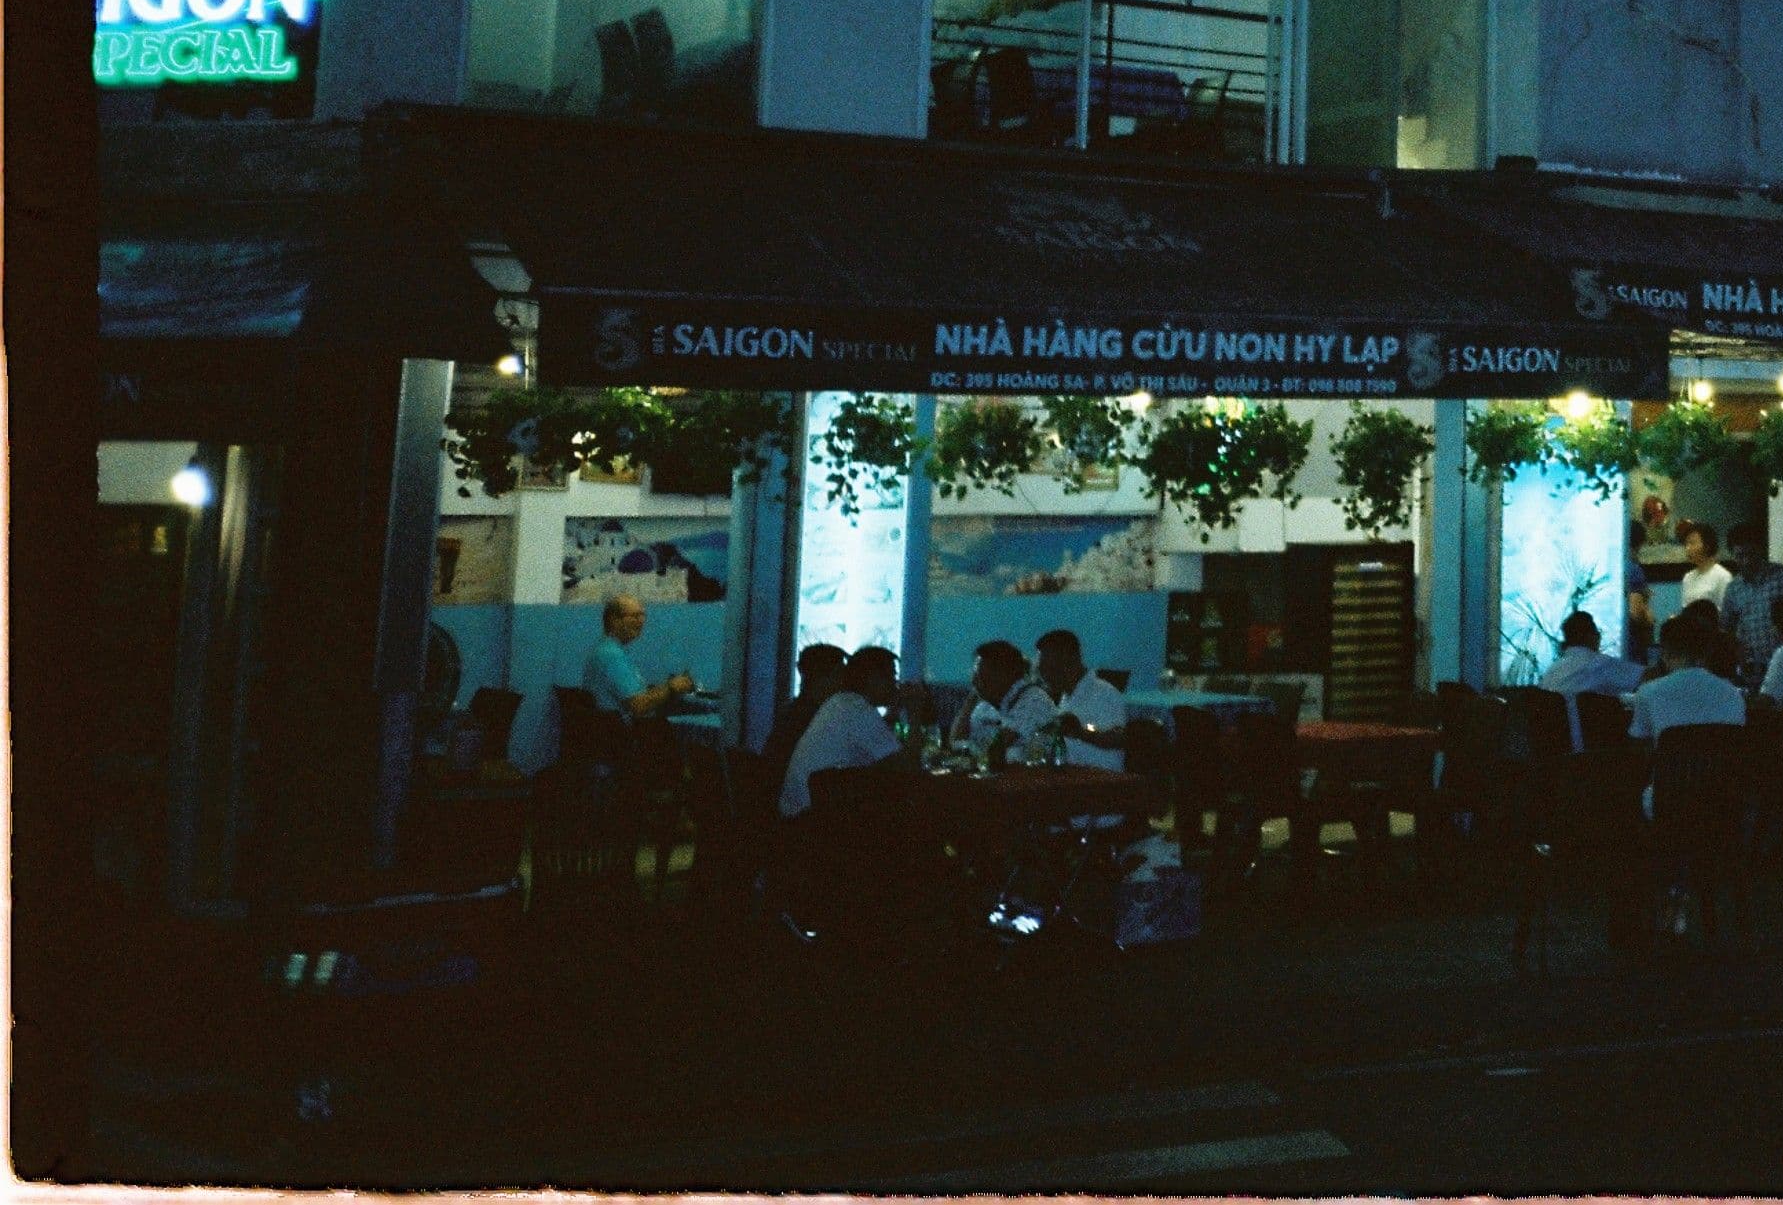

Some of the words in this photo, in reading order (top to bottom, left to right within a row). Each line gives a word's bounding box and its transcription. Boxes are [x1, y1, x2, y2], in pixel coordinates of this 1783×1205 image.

[1616, 284, 1688, 310] SAIGON
[1702, 279, 1763, 314] NHÀ
[672, 324, 814, 359] SAIGON
[935, 316, 1013, 356] NHÀ
[1022, 318, 1124, 360] HÀNG
[1131, 322, 1207, 361] CỪU
[1214, 331, 1286, 362] NON
[1293, 334, 1336, 363] HY
[1342, 334, 1399, 373] LẠP
[1462, 345, 1560, 373] SAIGON
[997, 370, 1060, 389] HOÀNG
[1110, 371, 1135, 391] VÕ
